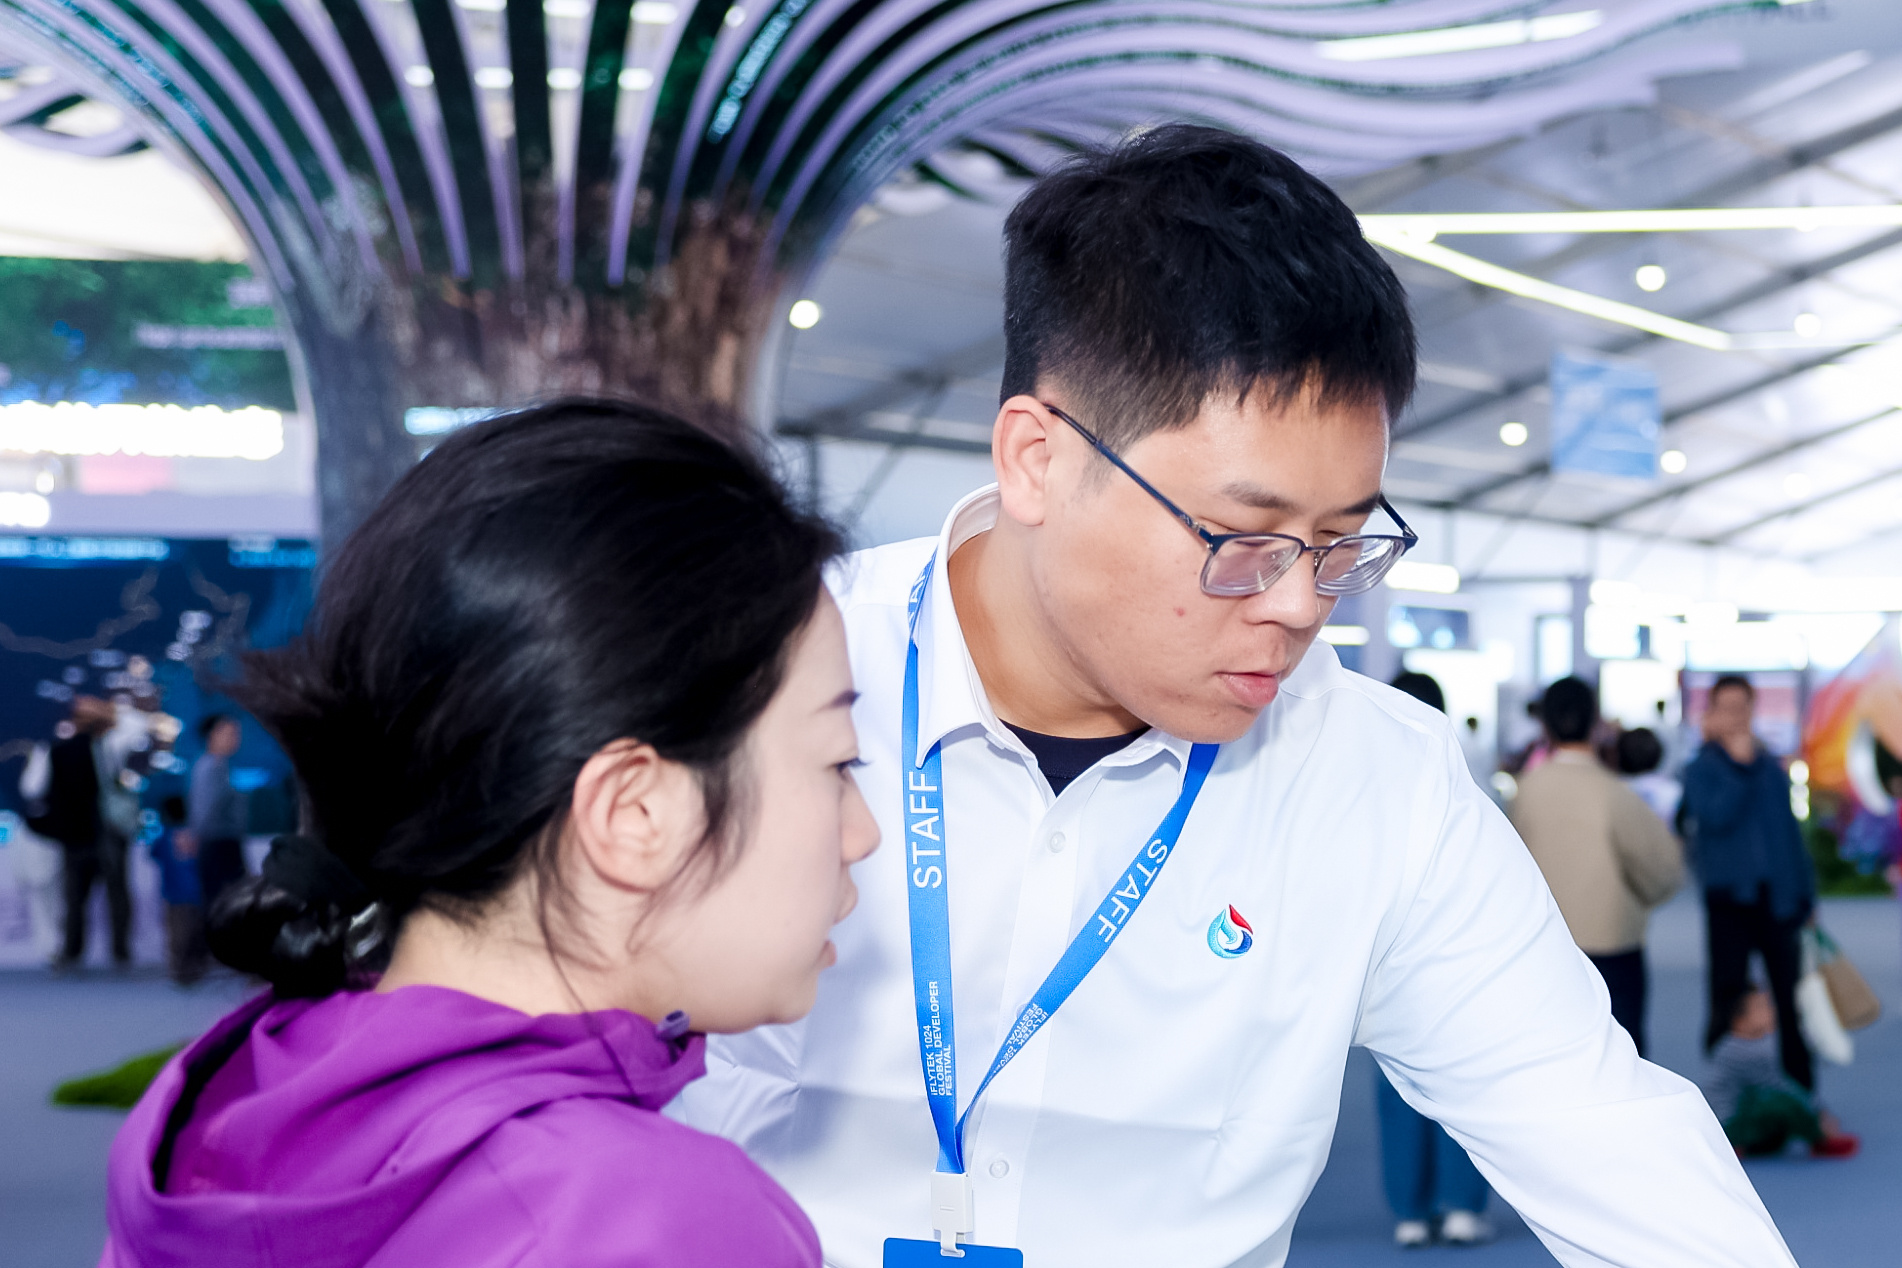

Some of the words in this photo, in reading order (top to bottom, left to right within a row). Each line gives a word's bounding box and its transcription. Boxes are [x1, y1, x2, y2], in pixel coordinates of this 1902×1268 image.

[908, 771, 942, 889] STAFF
[1098, 839, 1168, 943] STAFF
[923, 1025, 933, 1049] 1024
[929, 981, 943, 1048] DEVELOPER
[1006, 1003, 1039, 1046] FESTIVAL
[1013, 1007, 1043, 1045] GLOBAL
[926, 1052, 938, 1096] iFLYTEK
[935, 1050, 946, 1096] GLOBAL
[944, 1044, 953, 1096] FESTIVAL
